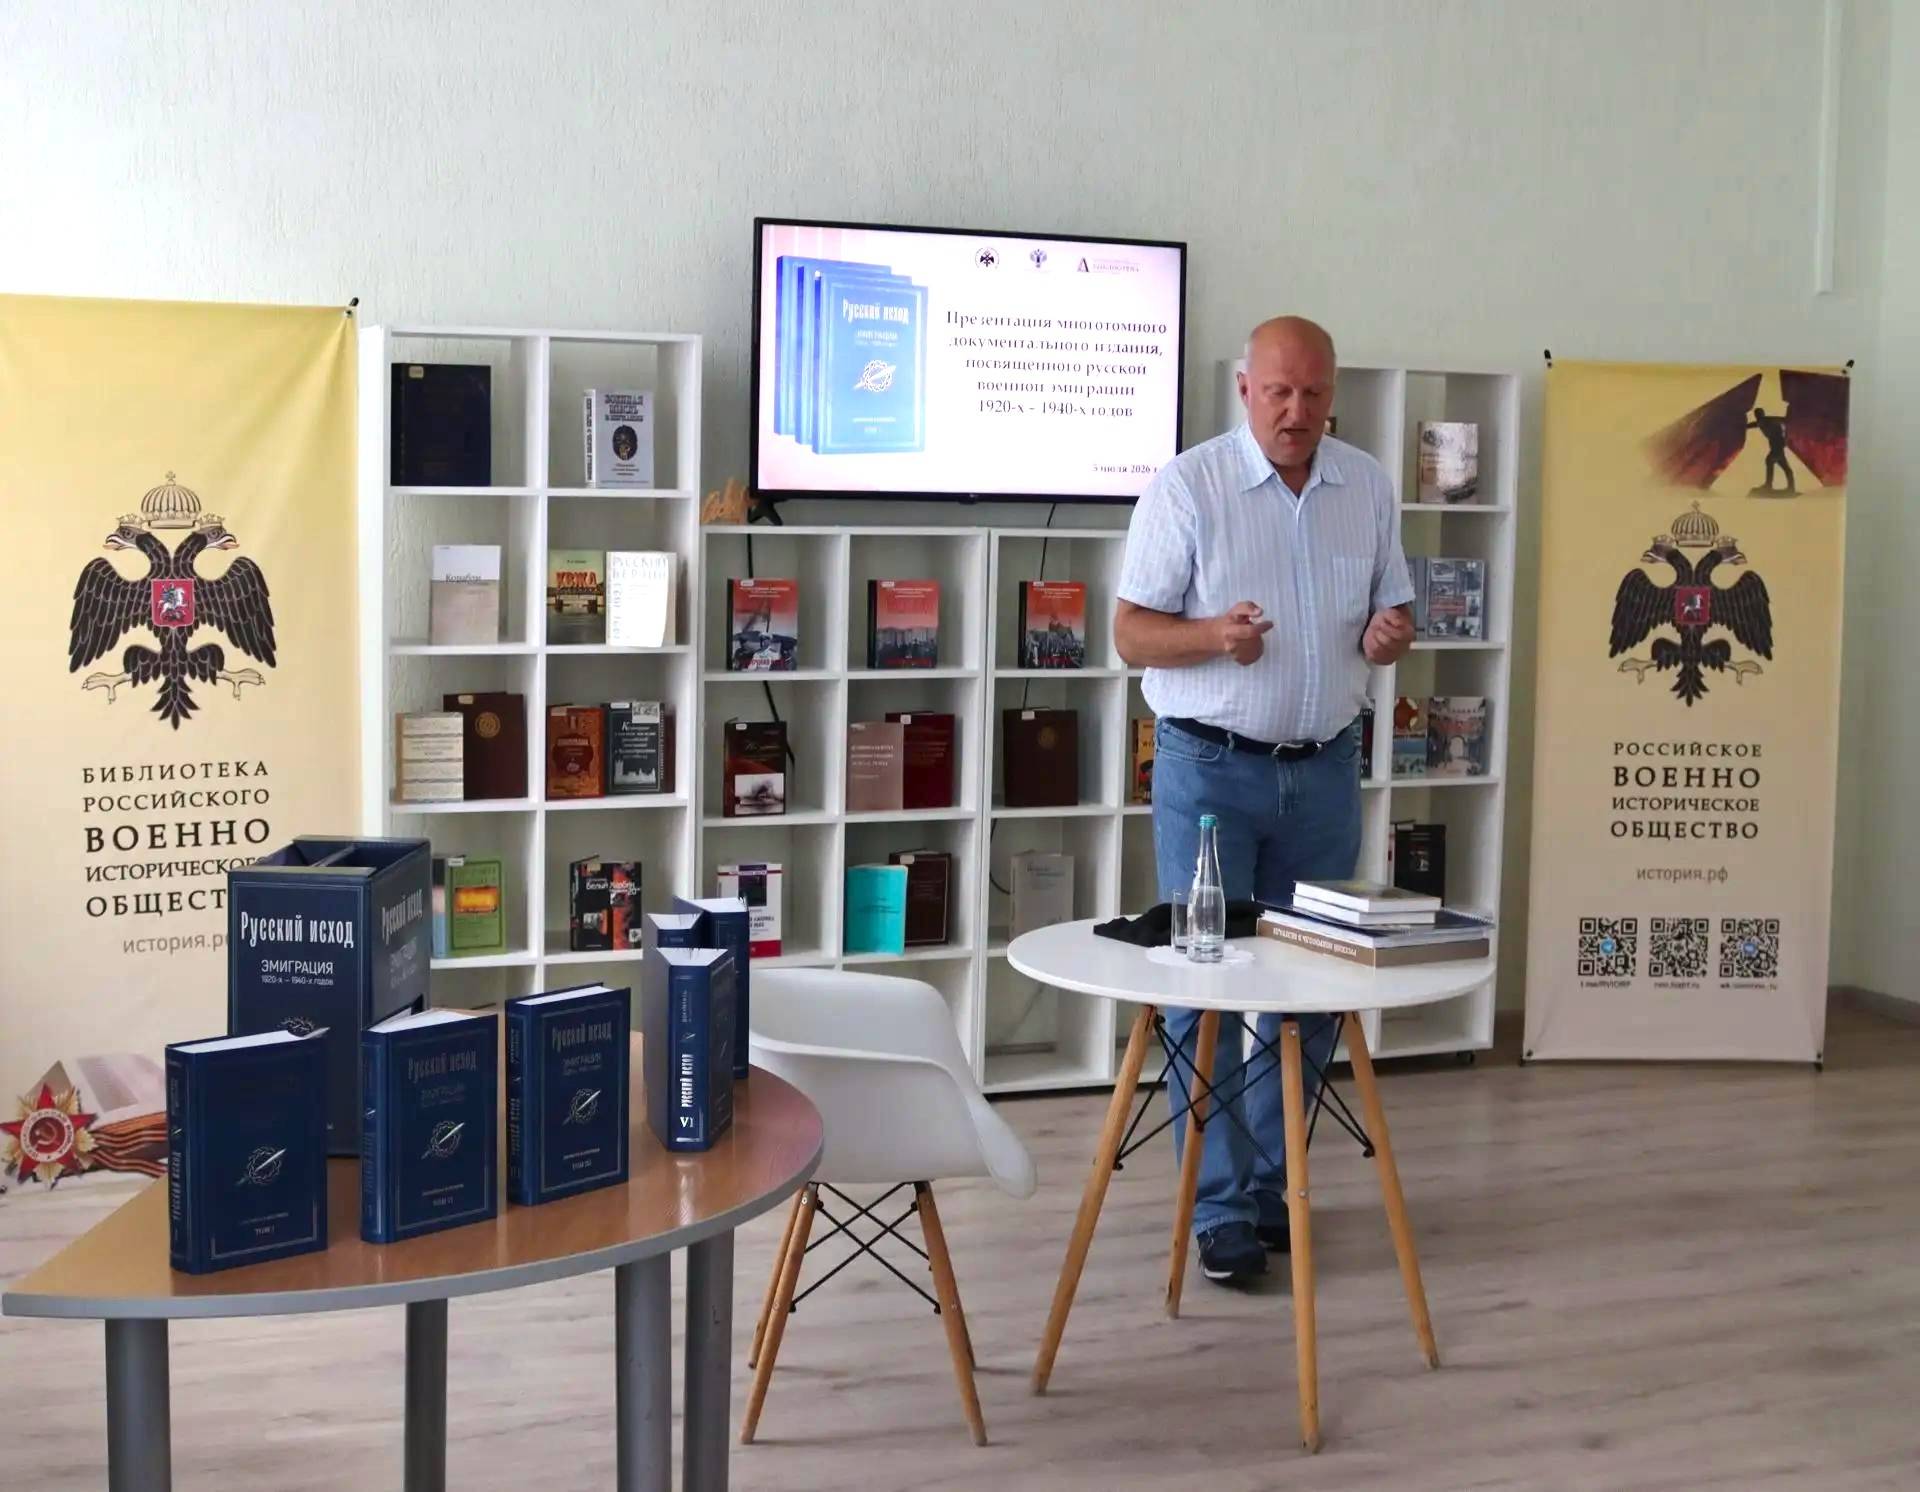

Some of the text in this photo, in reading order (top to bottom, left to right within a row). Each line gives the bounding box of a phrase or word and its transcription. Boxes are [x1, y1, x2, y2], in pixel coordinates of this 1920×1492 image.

[842, 299, 909, 325] Русский исход
[947, 311, 1168, 334] Презентация многотомного
[948, 336, 1163, 356] документального издания,
[965, 359, 1147, 377] посвященного русской
[1051, 384, 1136, 398] эмиграции
[979, 399, 1025, 414] 1920-х
[1042, 401, 1087, 416] 1940-х
[1091, 406, 1134, 417] годов
[1131, 464, 1151, 474] 2026
[1613, 741, 1763, 758] РОССИЙСКОЕ
[82, 760, 269, 784] БИБЛИОТЕКА
[1613, 765, 1761, 789] ВОЕННО
[83, 788, 270, 813] РОССИЙСКОГО
[1611, 796, 1761, 812] ИСТОРИЧЕСКОЕ
[84, 818, 270, 853] ВОЕННО
[1610, 820, 1760, 841] ОБЩЕСТВО
[1636, 866, 1729, 884] история.рф
[86, 888, 227, 918] ОБЩЕСТ
[382, 888, 422, 946] Русский исход
[241, 911, 354, 949] Русский исход
[123, 933, 228, 955] история.р
[261, 959, 334, 975] ЭМИГРАЦИЯ
[408, 1052, 447, 1084] Русский
